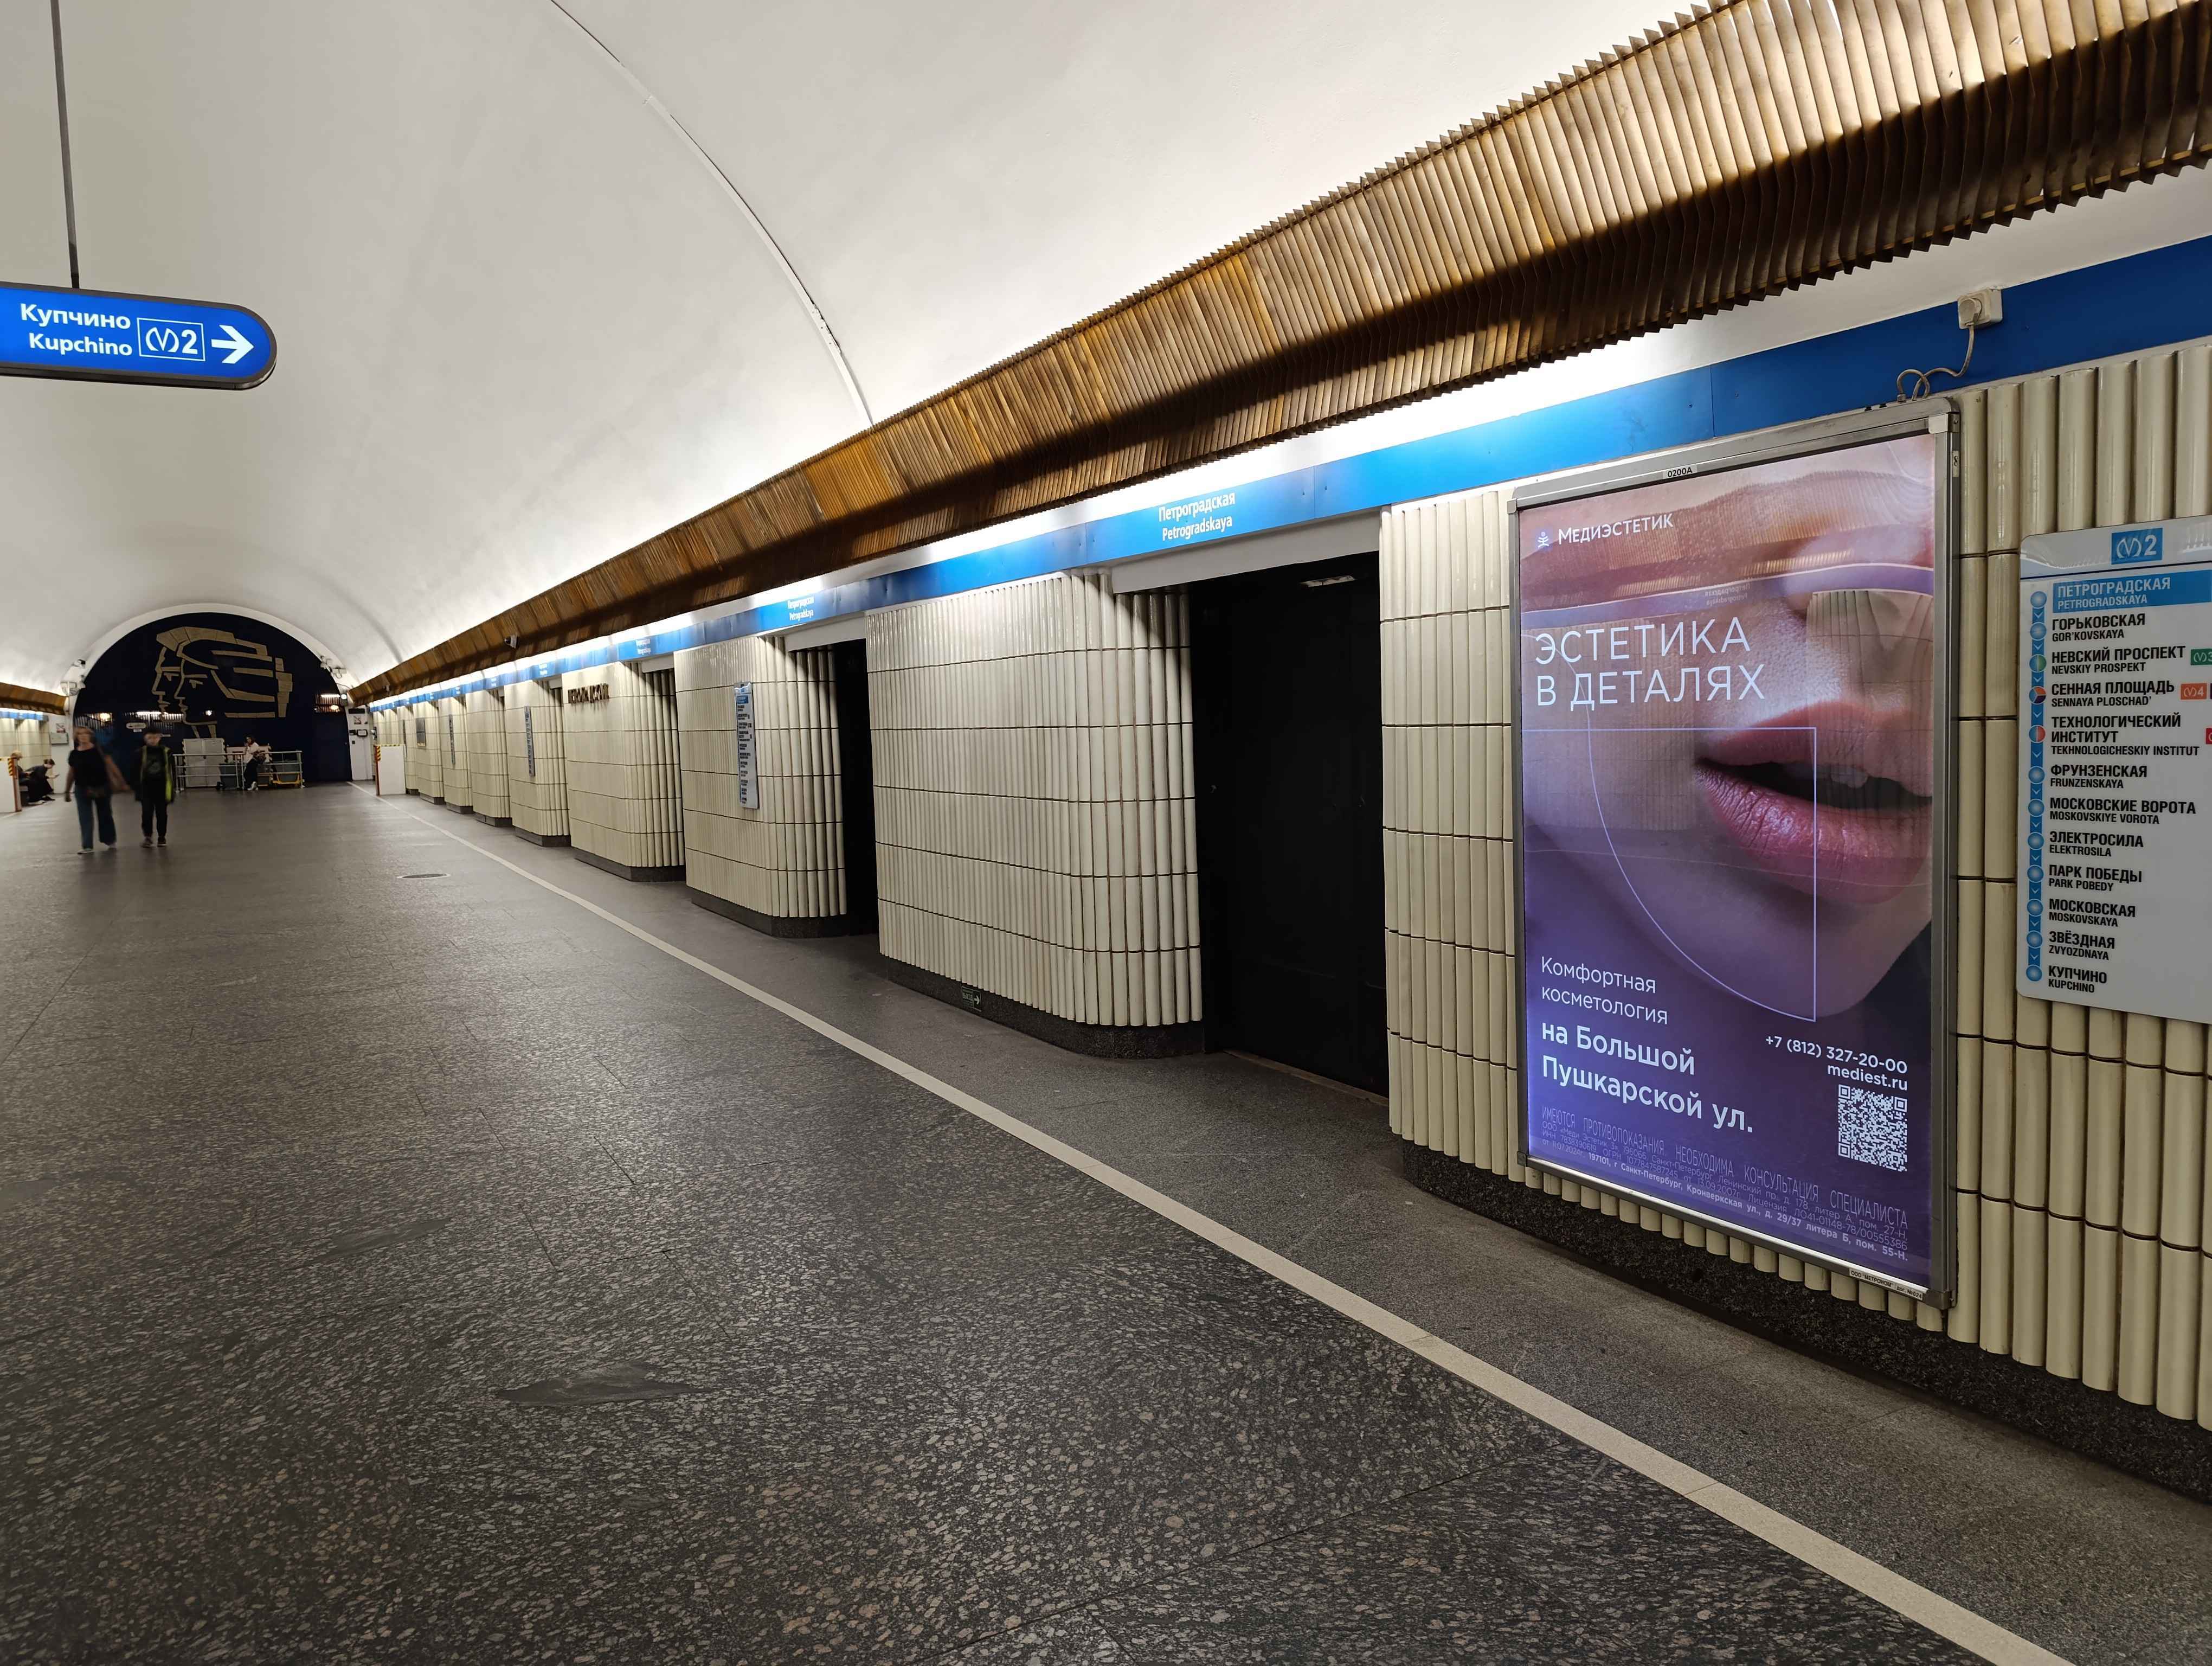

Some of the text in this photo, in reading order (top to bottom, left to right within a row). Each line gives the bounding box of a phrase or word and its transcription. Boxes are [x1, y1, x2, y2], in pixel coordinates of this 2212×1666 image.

[20, 303, 131, 329] Купчино
[29, 333, 132, 356] Kupchino
[1159, 492, 1235, 522] Петроградская
[1162, 515, 1232, 541] Petrogradskaya
[2058, 576, 2171, 598] ПЕТРОГРАДСКАЯ
[2058, 594, 2147, 610] PETROGRADSKAYA
[2052, 613, 2145, 631] ГОРЬКОВСКАЯ
[1535, 616, 1751, 664] ЭСТЕТИКА
[2052, 645, 2185, 663] НЕВСКИЙ ПРОСПЕКТ
[2052, 662, 2146, 675] NEVSKIY PROSPEKT
[1538, 663, 1765, 712] В ДЕТАЛЯХ
[2052, 680, 2175, 695] СЕННАЯ ПЛОЩАДЬ
[2052, 696, 2094, 707] SENNAYA
[2052, 713, 2181, 728] ТЕХНОЛОГИЧЕСКИЙ
[2052, 731, 2118, 743] ИНСТИТУТ
[2051, 746, 2200, 756] TEKHNOLOGICHESKIY INSTITUT
[2050, 764, 2147, 777] ФРУНЗЕНСКАЯ
[2050, 778, 2124, 789] FRUNZENSKAYA
[2050, 797, 2196, 814] МОСКОВСКИЕ ВОРОТА
[2050, 811, 2159, 824] MOSKOVSKIYE VOROTA
[2049, 831, 2144, 847] ЭЛЕКТРОСИЛА
[2049, 844, 2111, 857] ELEKTROSILA
[2049, 864, 2142, 883] ПАРК ПОБЕДЫ
[2049, 878, 2114, 892] PARK POBEDY
[2049, 898, 2136, 918] МОСКОВСКАЯ
[2049, 912, 2118, 927] MOSKOVSKAYA
[2049, 930, 2115, 949] ЗВЁЗДНАЯ
[2048, 945, 2109, 960] ZVYOZDNAYA
[1541, 956, 1656, 994] Комфортная
[2048, 965, 2107, 984] КУПЧИНО
[2048, 980, 2095, 993] KUPCHINO
[1541, 986, 1668, 1024] косметология
[1542, 1022, 1695, 1075] на Большой
[1766, 1035, 1907, 1074] +7 (812) 327-20-00
[1827, 1064, 1907, 1091] mediest.ru
[1543, 1055, 1752, 1133] Пушкарской ул.
[1542, 1106, 1575, 1128] ИМЕЮТСЯ
[1676, 1145, 1734, 1177] НЕОБХОДИМА
[1744, 1164, 1818, 1202] КОНСУЛЬТАЦИЯ
[1830, 1190, 1908, 1229] СПЕЦИАЛИСТА
[1542, 1120, 1557, 1132] ООО
[1719, 1175, 1761, 1195] Ленинский
[1815, 1207, 1840, 1220] литер
[1542, 1129, 1556, 1139] ИНН
[1603, 1148, 1622, 1159] ОГРН
[1748, 1194, 1787, 1212] Лицензия
[1621, 1163, 1683, 1191] Санкт-Петербург,
[1687, 1183, 1742, 1208] Кронверкская
[1765, 1210, 1773, 1219] д.
[1777, 1213, 1801, 1226] 29/37
[1806, 1223, 1838, 1239] литера
[1843, 1233, 1851, 1245] Б,
[1856, 1239, 1877, 1251] пом.
